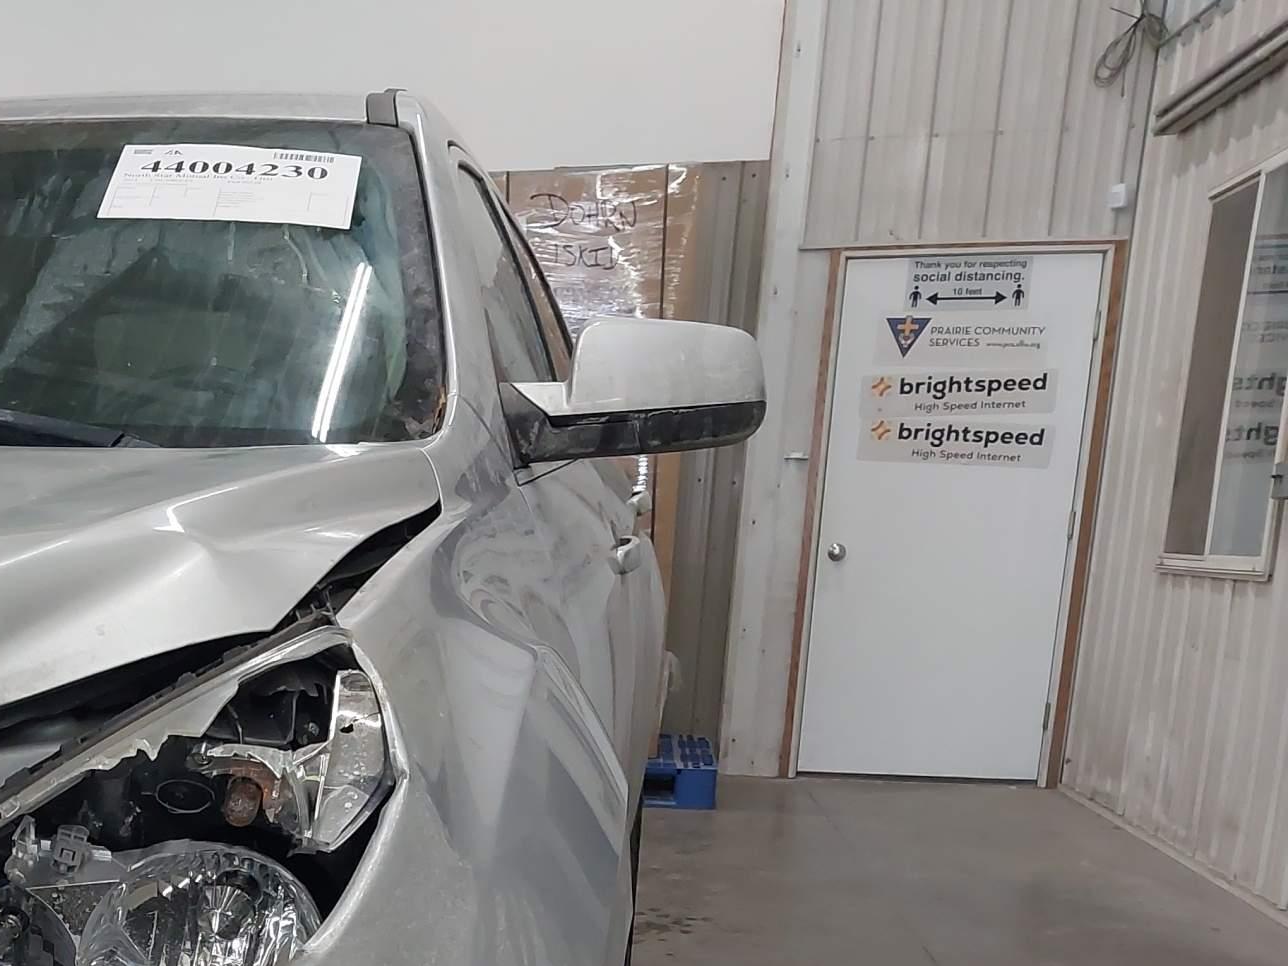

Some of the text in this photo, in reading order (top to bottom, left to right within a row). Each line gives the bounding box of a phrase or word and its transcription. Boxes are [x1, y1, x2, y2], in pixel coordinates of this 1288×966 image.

[141, 160, 328, 180] 44004230
[915, 261, 941, 269] Thank
[944, 262, 962, 271] you
[979, 259, 1028, 269] respecting
[913, 270, 1025, 283] social distancing.
[930, 326, 1046, 336] PRAIRIE COMMUNITY
[929, 338, 980, 347] SERVICES
[899, 372, 1048, 400] brightspeed
[914, 400, 1026, 413] High Speed Internet
[898, 422, 1045, 448] brightspeed
[911, 449, 1022, 463] High Speed Internet
